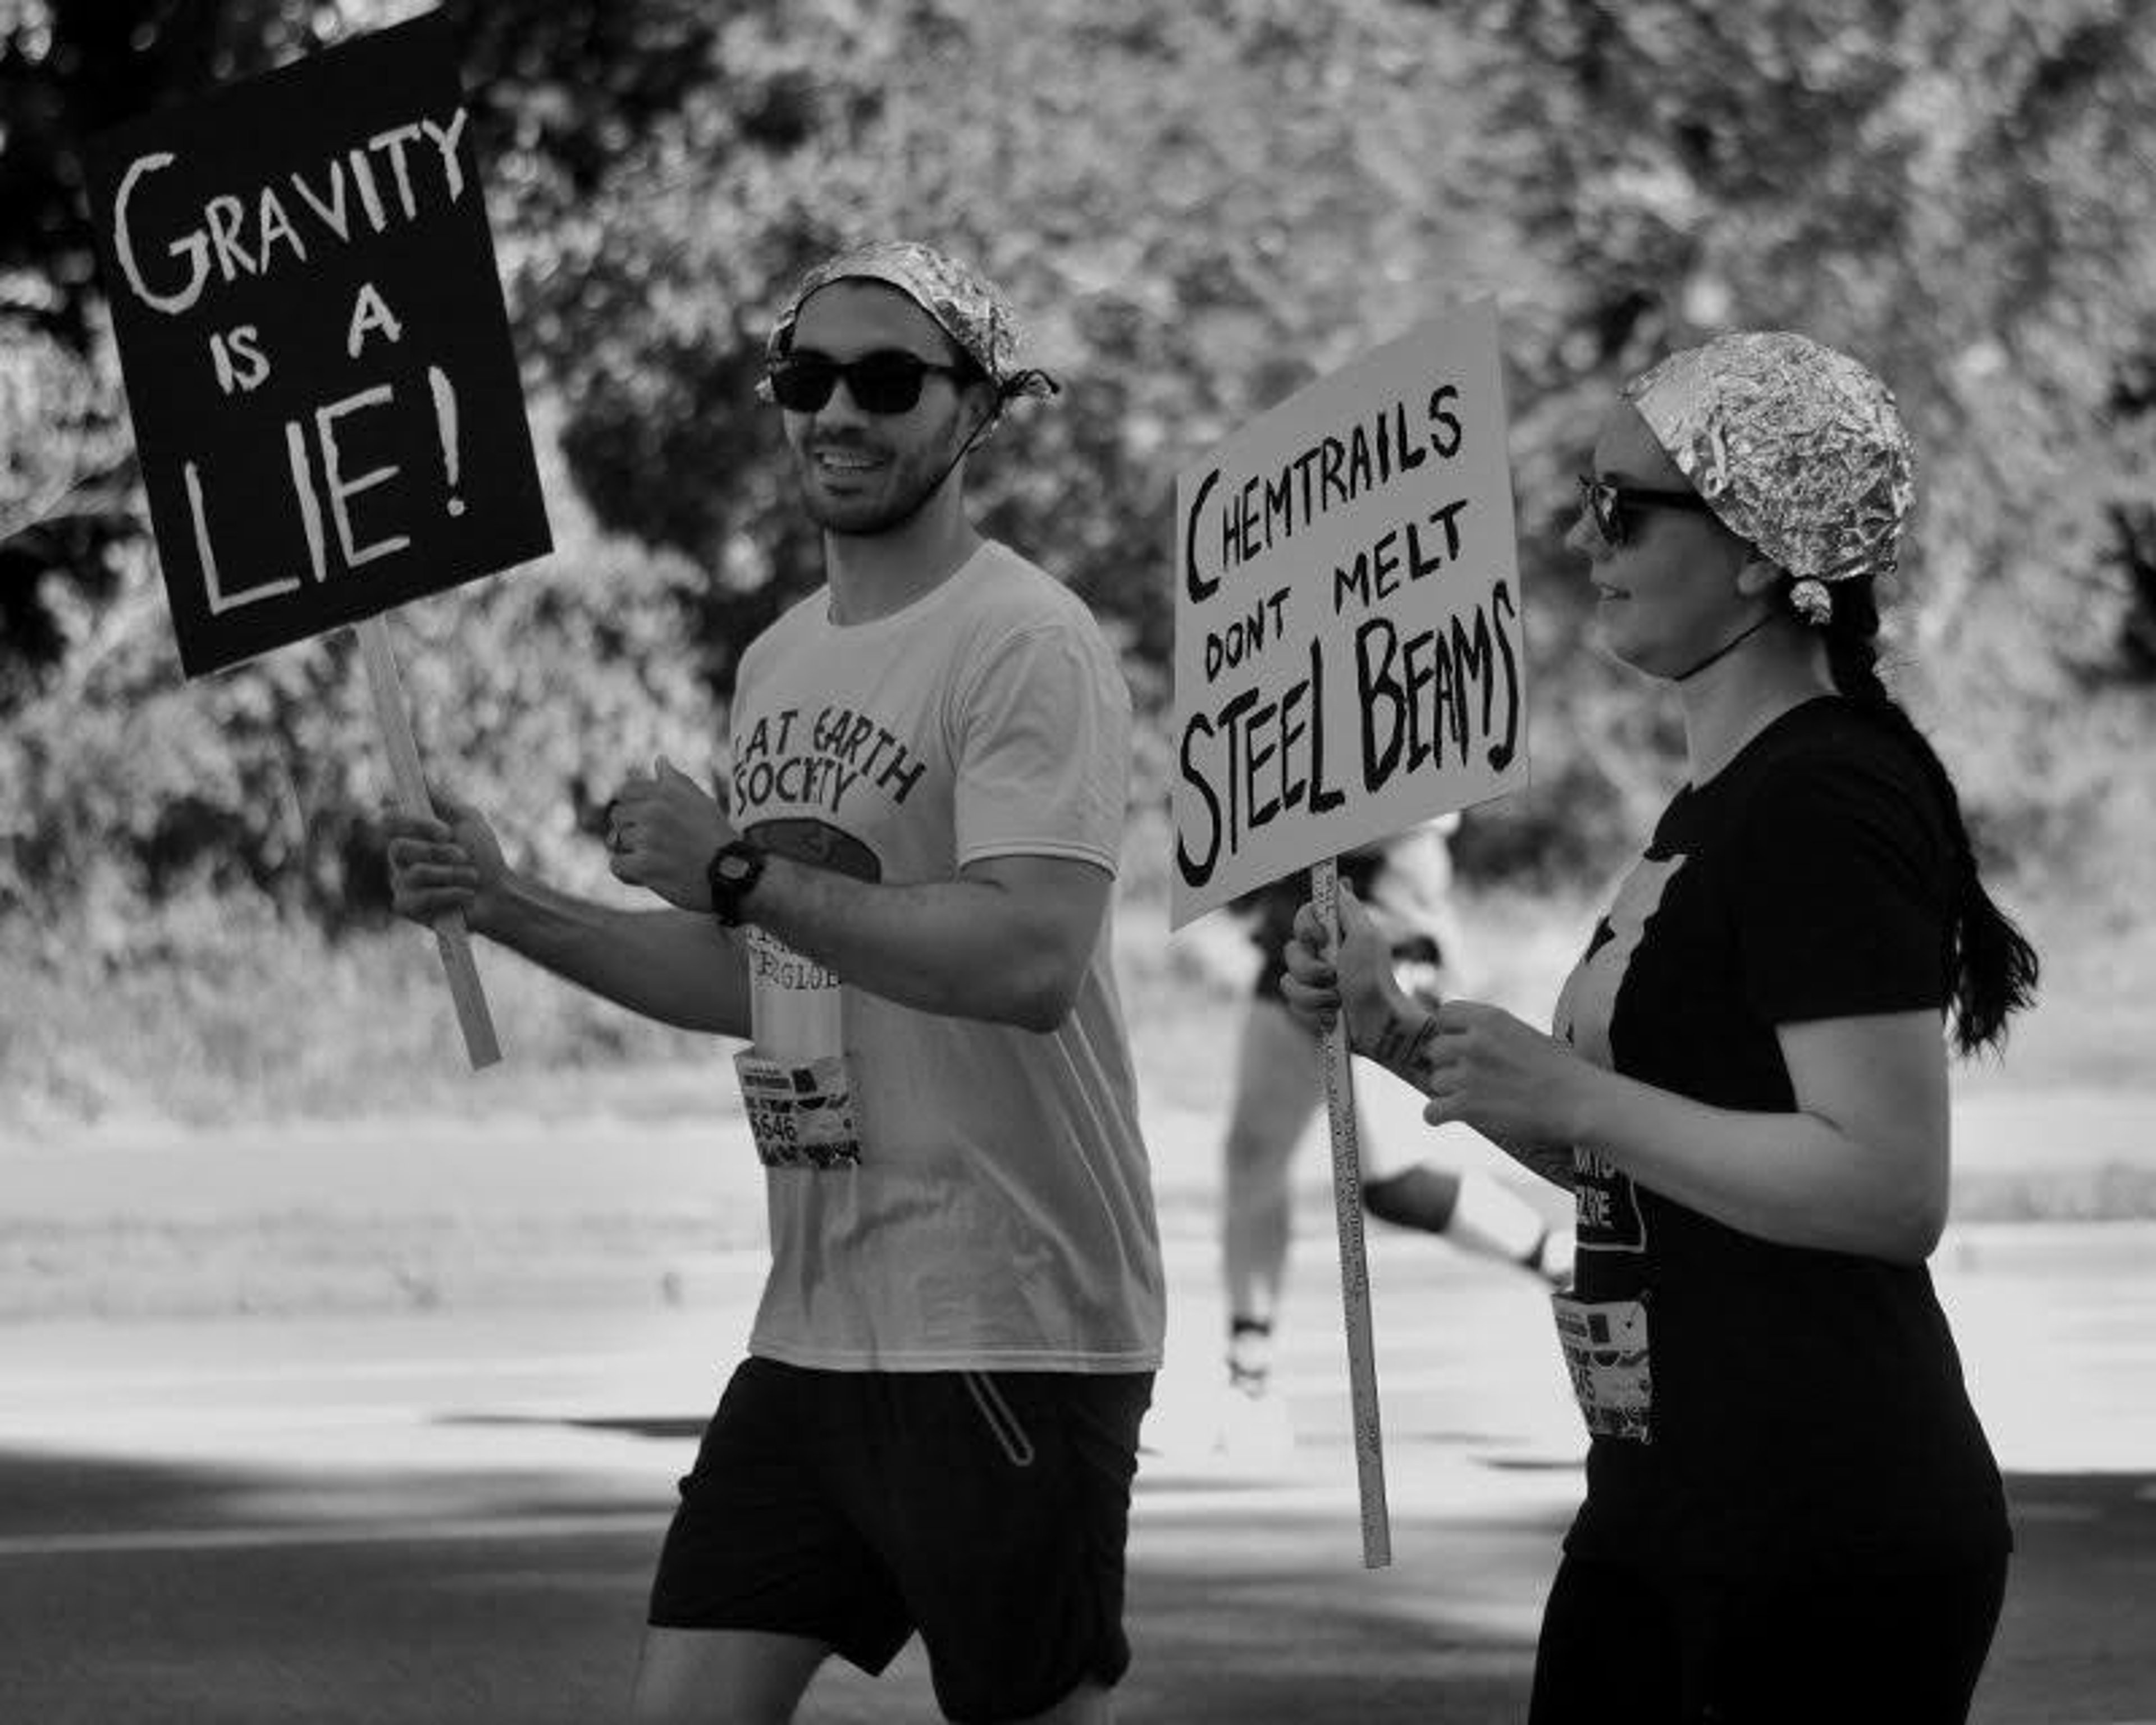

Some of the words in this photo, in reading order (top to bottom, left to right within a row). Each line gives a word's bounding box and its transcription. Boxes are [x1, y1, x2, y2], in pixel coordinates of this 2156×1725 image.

[115, 108, 467, 314] GRAVITY
[210, 325, 270, 394] IS
[348, 282, 402, 358] A
[185, 365, 465, 615] LIE!
[1186, 384, 1462, 603] CHEMTRAILS
[1205, 586, 1292, 682] DONT
[1333, 499, 1468, 615] MELT
[814, 706, 926, 805] EARTH
[1177, 636, 1346, 888] STEEL
[1355, 579, 1519, 793] BEAMS
